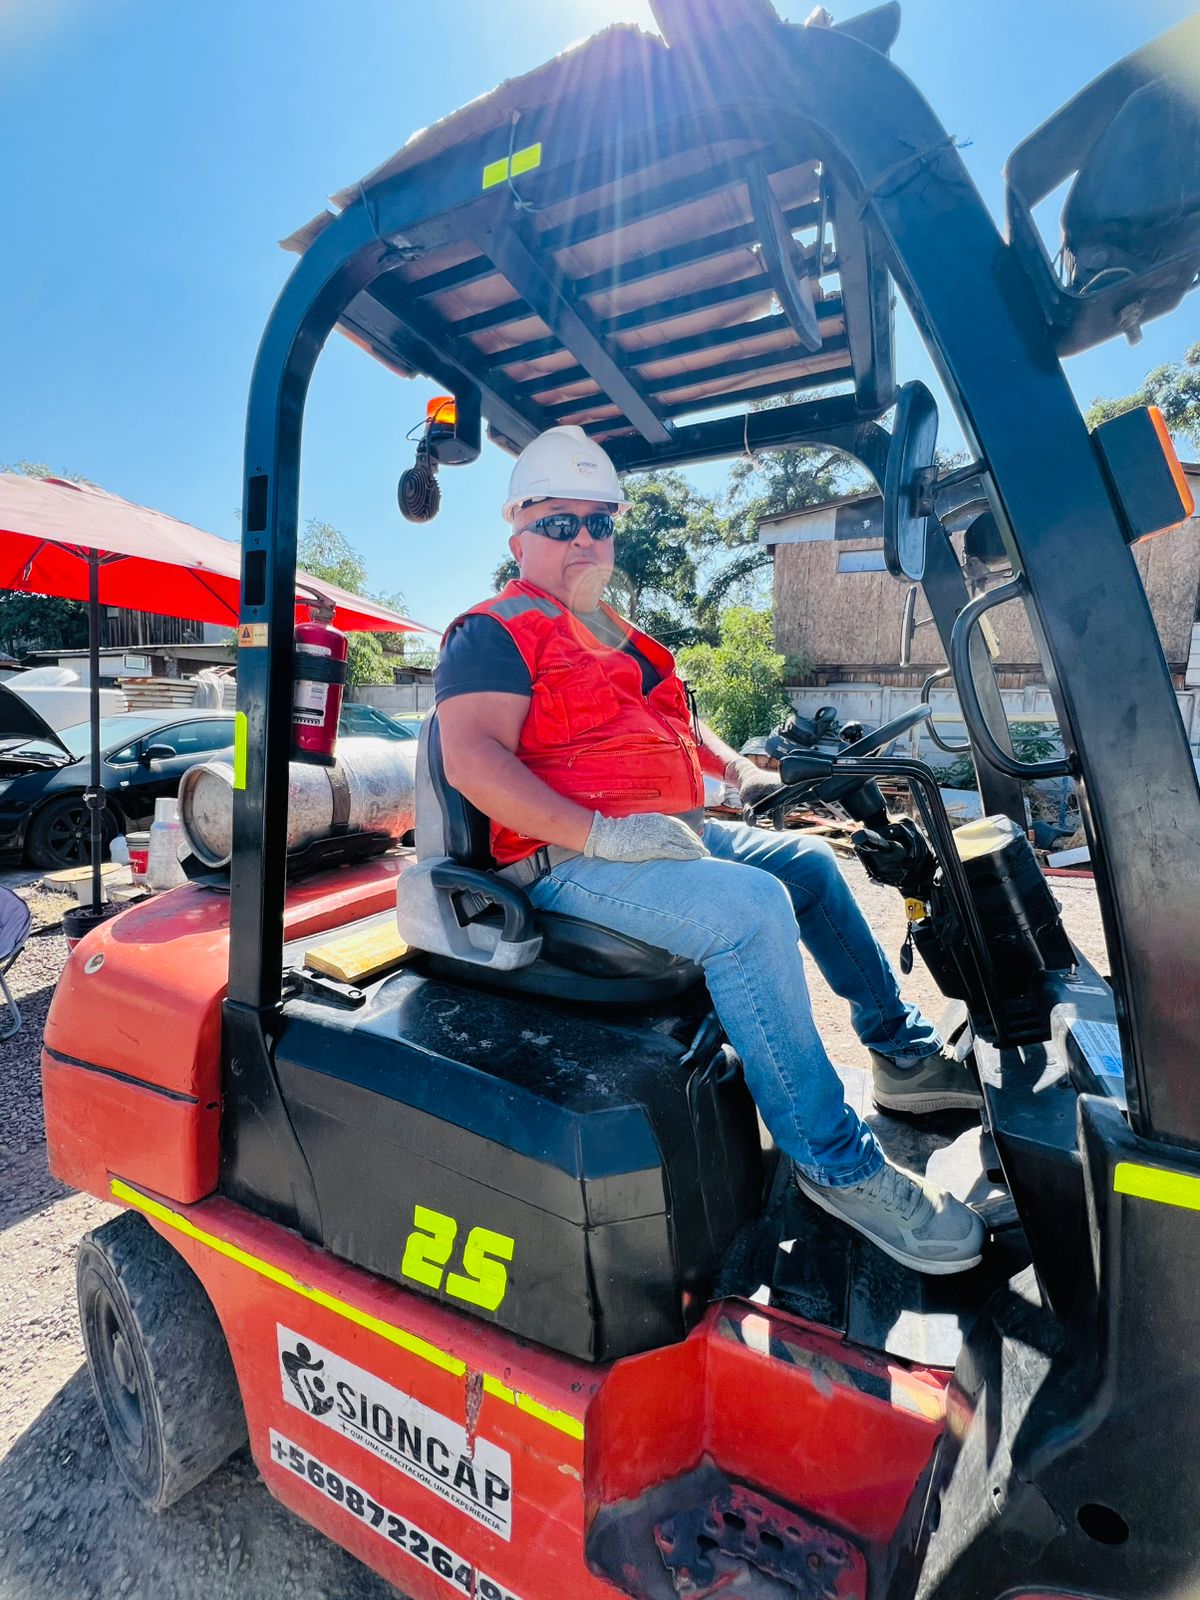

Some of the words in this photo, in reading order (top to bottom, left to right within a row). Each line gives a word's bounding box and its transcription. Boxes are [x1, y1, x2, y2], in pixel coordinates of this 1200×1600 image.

[401, 1204, 515, 1312] 25
[337, 1381, 511, 1509] SIONCAP
[350, 1429, 364, 1441] QUE
[365, 1438, 379, 1453] UNA
[433, 1482, 450, 1498] UNA
[271, 1440, 520, 1600] +5698722649
